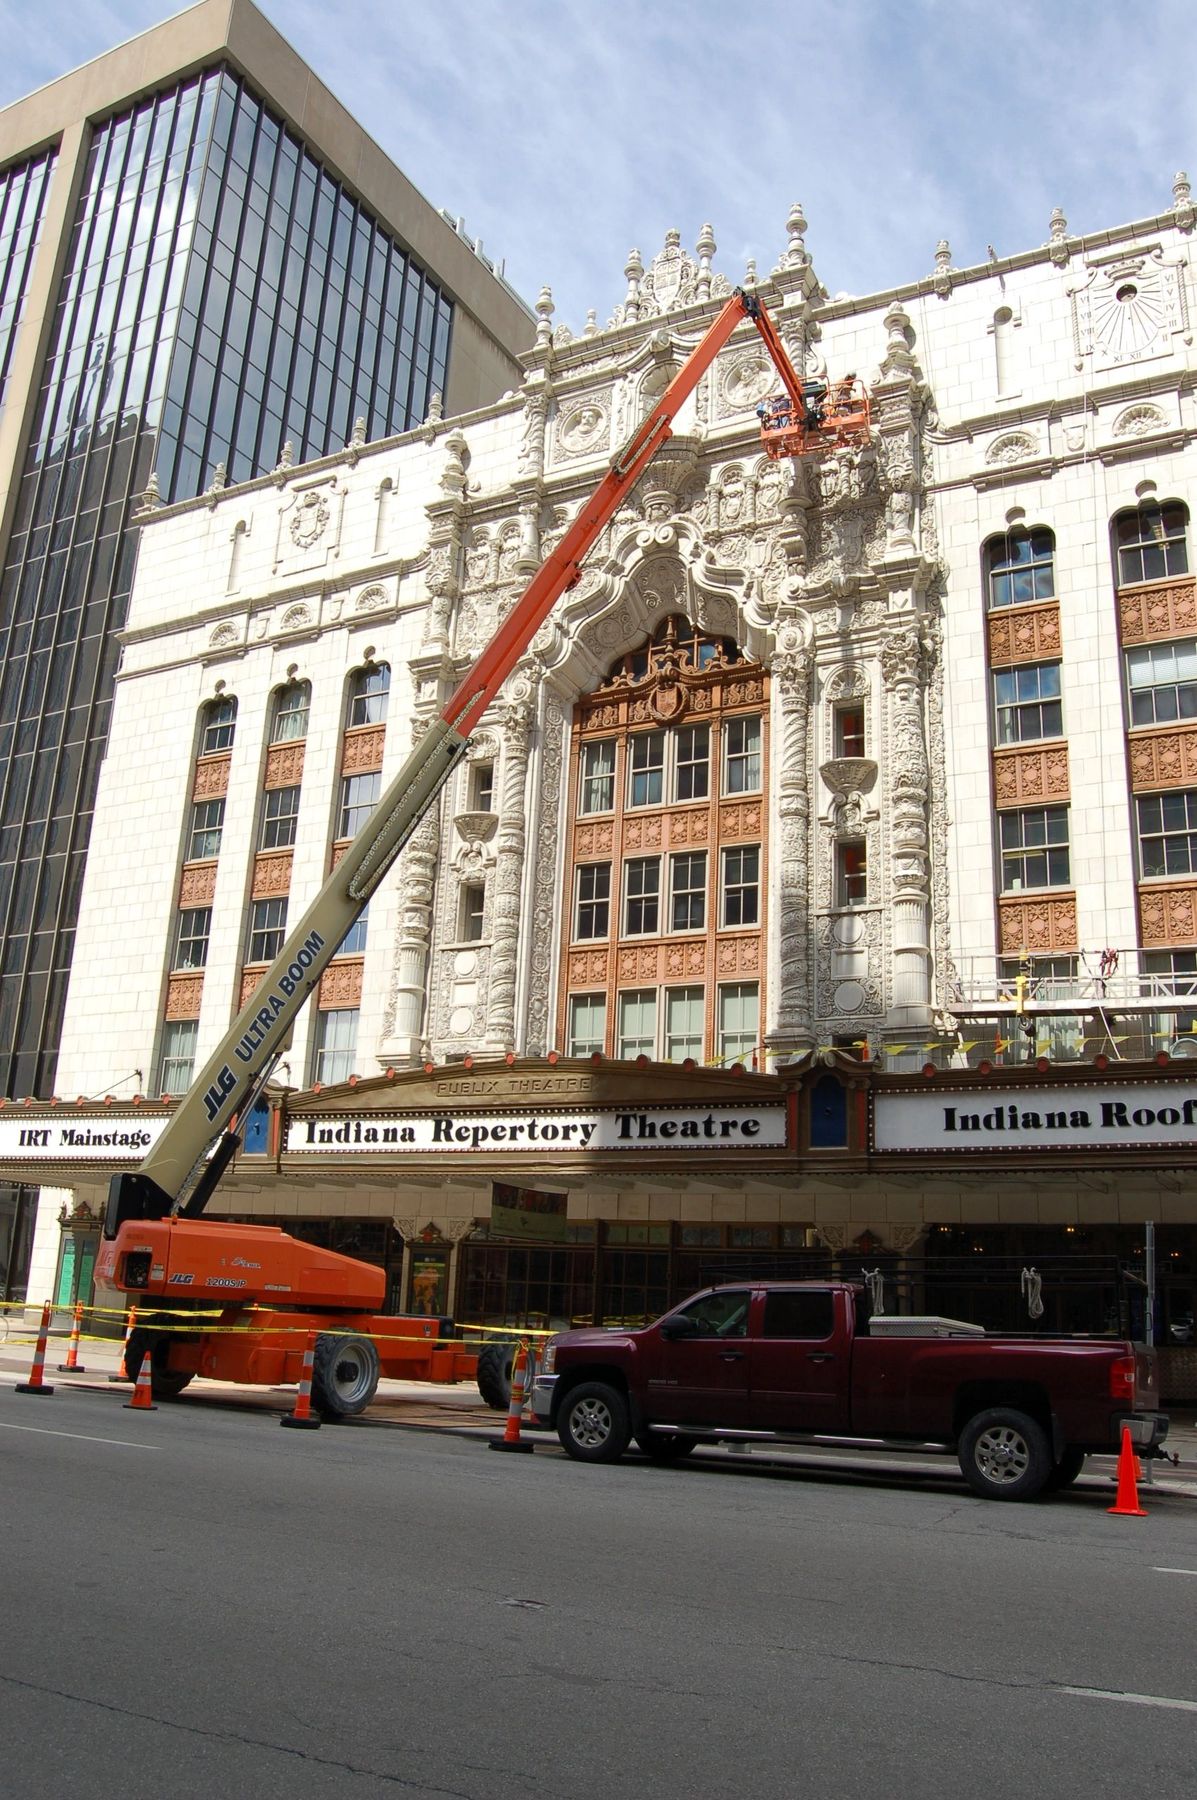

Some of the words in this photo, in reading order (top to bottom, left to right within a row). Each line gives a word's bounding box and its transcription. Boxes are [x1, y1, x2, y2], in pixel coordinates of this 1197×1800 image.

[1166, 288, 1174, 296] V
[1165, 303, 1175, 311] IV
[203, 1065, 238, 1123] JLG
[234, 994, 286, 1062] ULTRA
[278, 930, 325, 998] BOOM
[437, 1081, 499, 1094] PUBLIX
[508, 1078, 590, 1092] THEATRE
[943, 1105, 1092, 1131] Indiana
[1100, 1099, 1197, 1128] Roof
[305, 1121, 416, 1144] Indiana
[431, 1118, 597, 1147] Repertory
[614, 1113, 760, 1139] Theatre
[18, 1129, 52, 1147] IRT
[59, 1129, 152, 1149] Mainstage
[168, 1273, 195, 1285] JLG
[206, 1277, 247, 1288] 1200SJP
